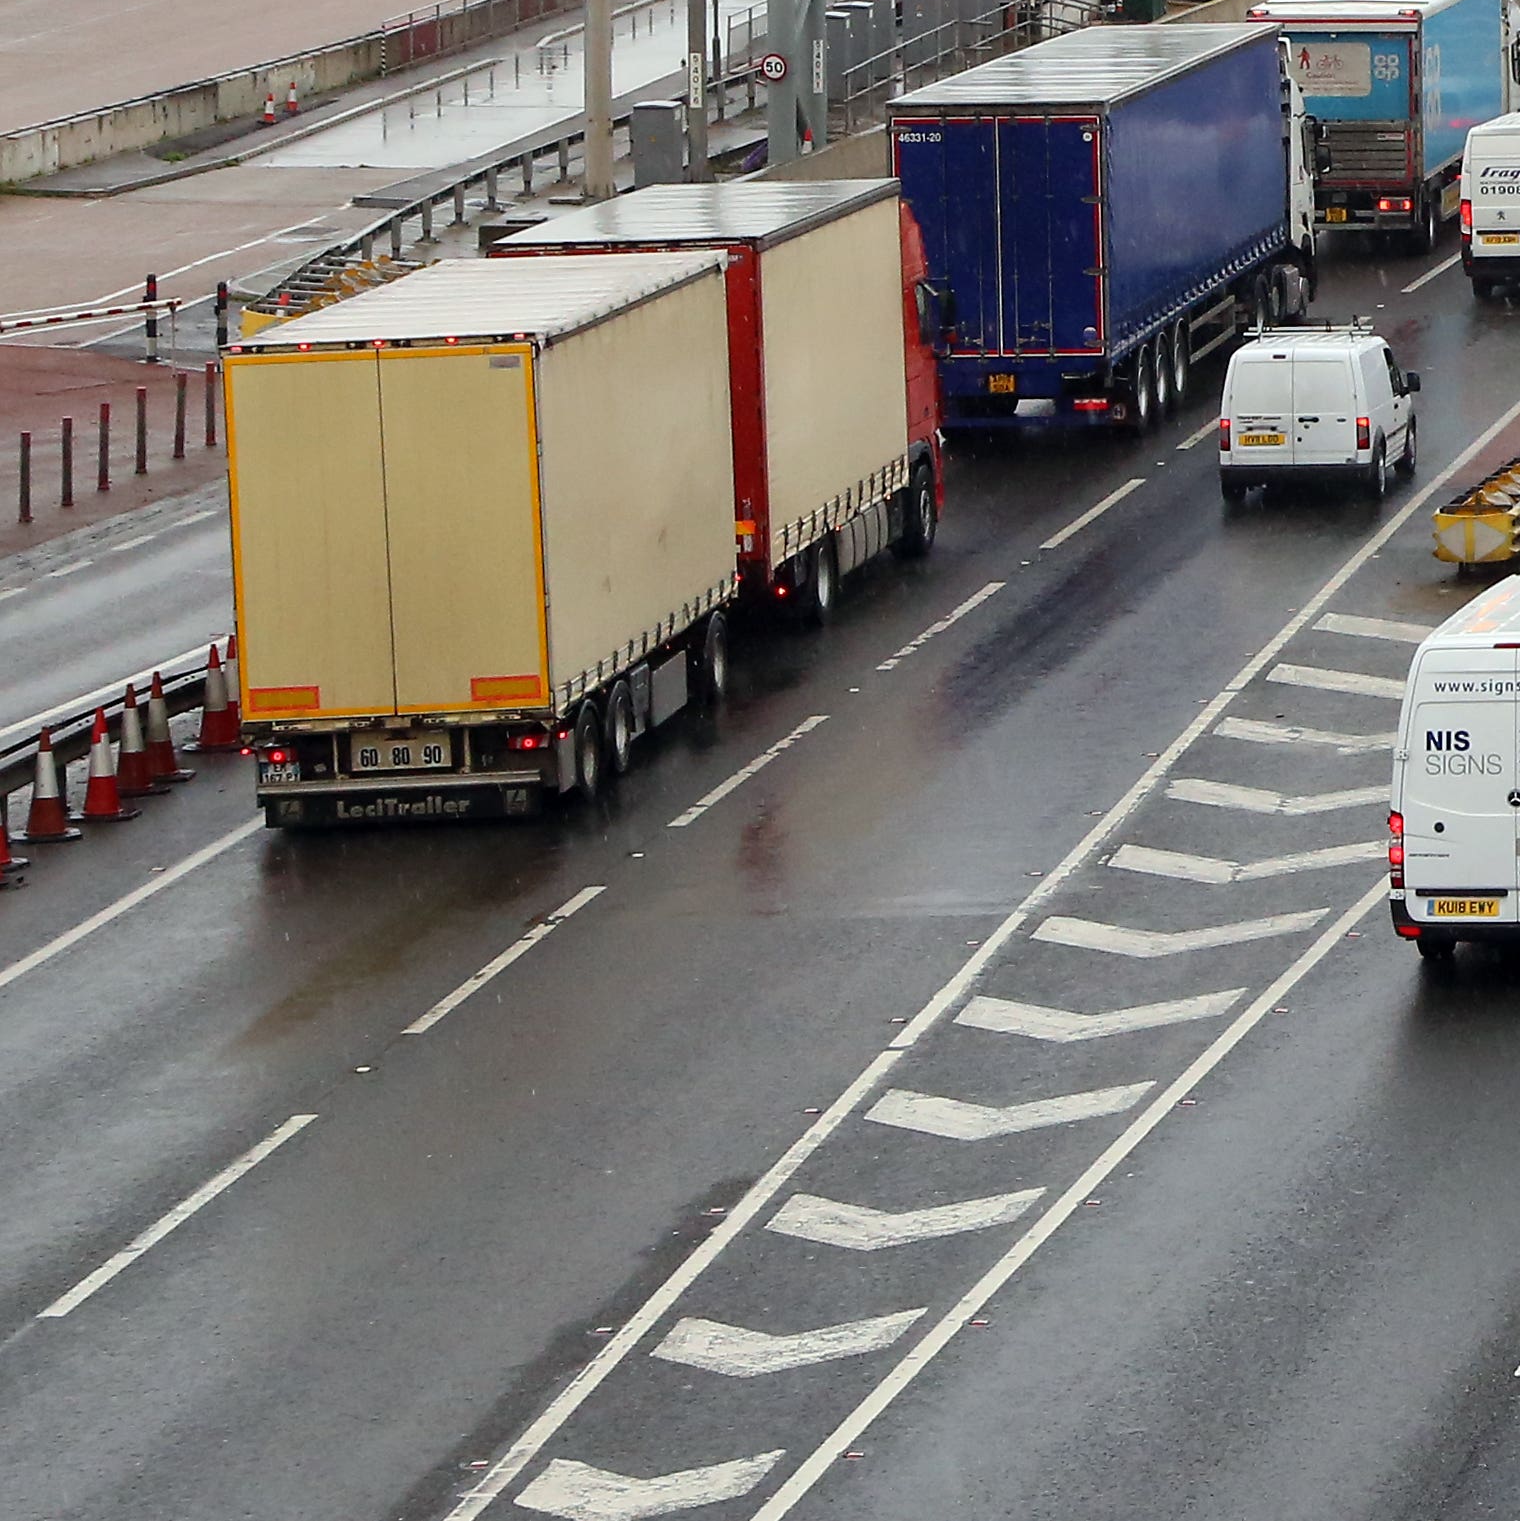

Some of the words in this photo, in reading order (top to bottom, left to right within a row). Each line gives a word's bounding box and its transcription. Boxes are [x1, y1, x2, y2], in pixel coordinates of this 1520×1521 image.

[766, 61, 783, 73] 50
[898, 133, 942, 143] 46331-20
[1426, 730, 1470, 751] NIS
[360, 749, 378, 767] 60
[393, 747, 410, 766] 80
[423, 745, 441, 764] 90
[1426, 754, 1502, 776] SIGNS
[336, 796, 470, 818] LeciTrailer
[1438, 901, 1467, 914] KU18
[1469, 901, 1495, 914] EWY
